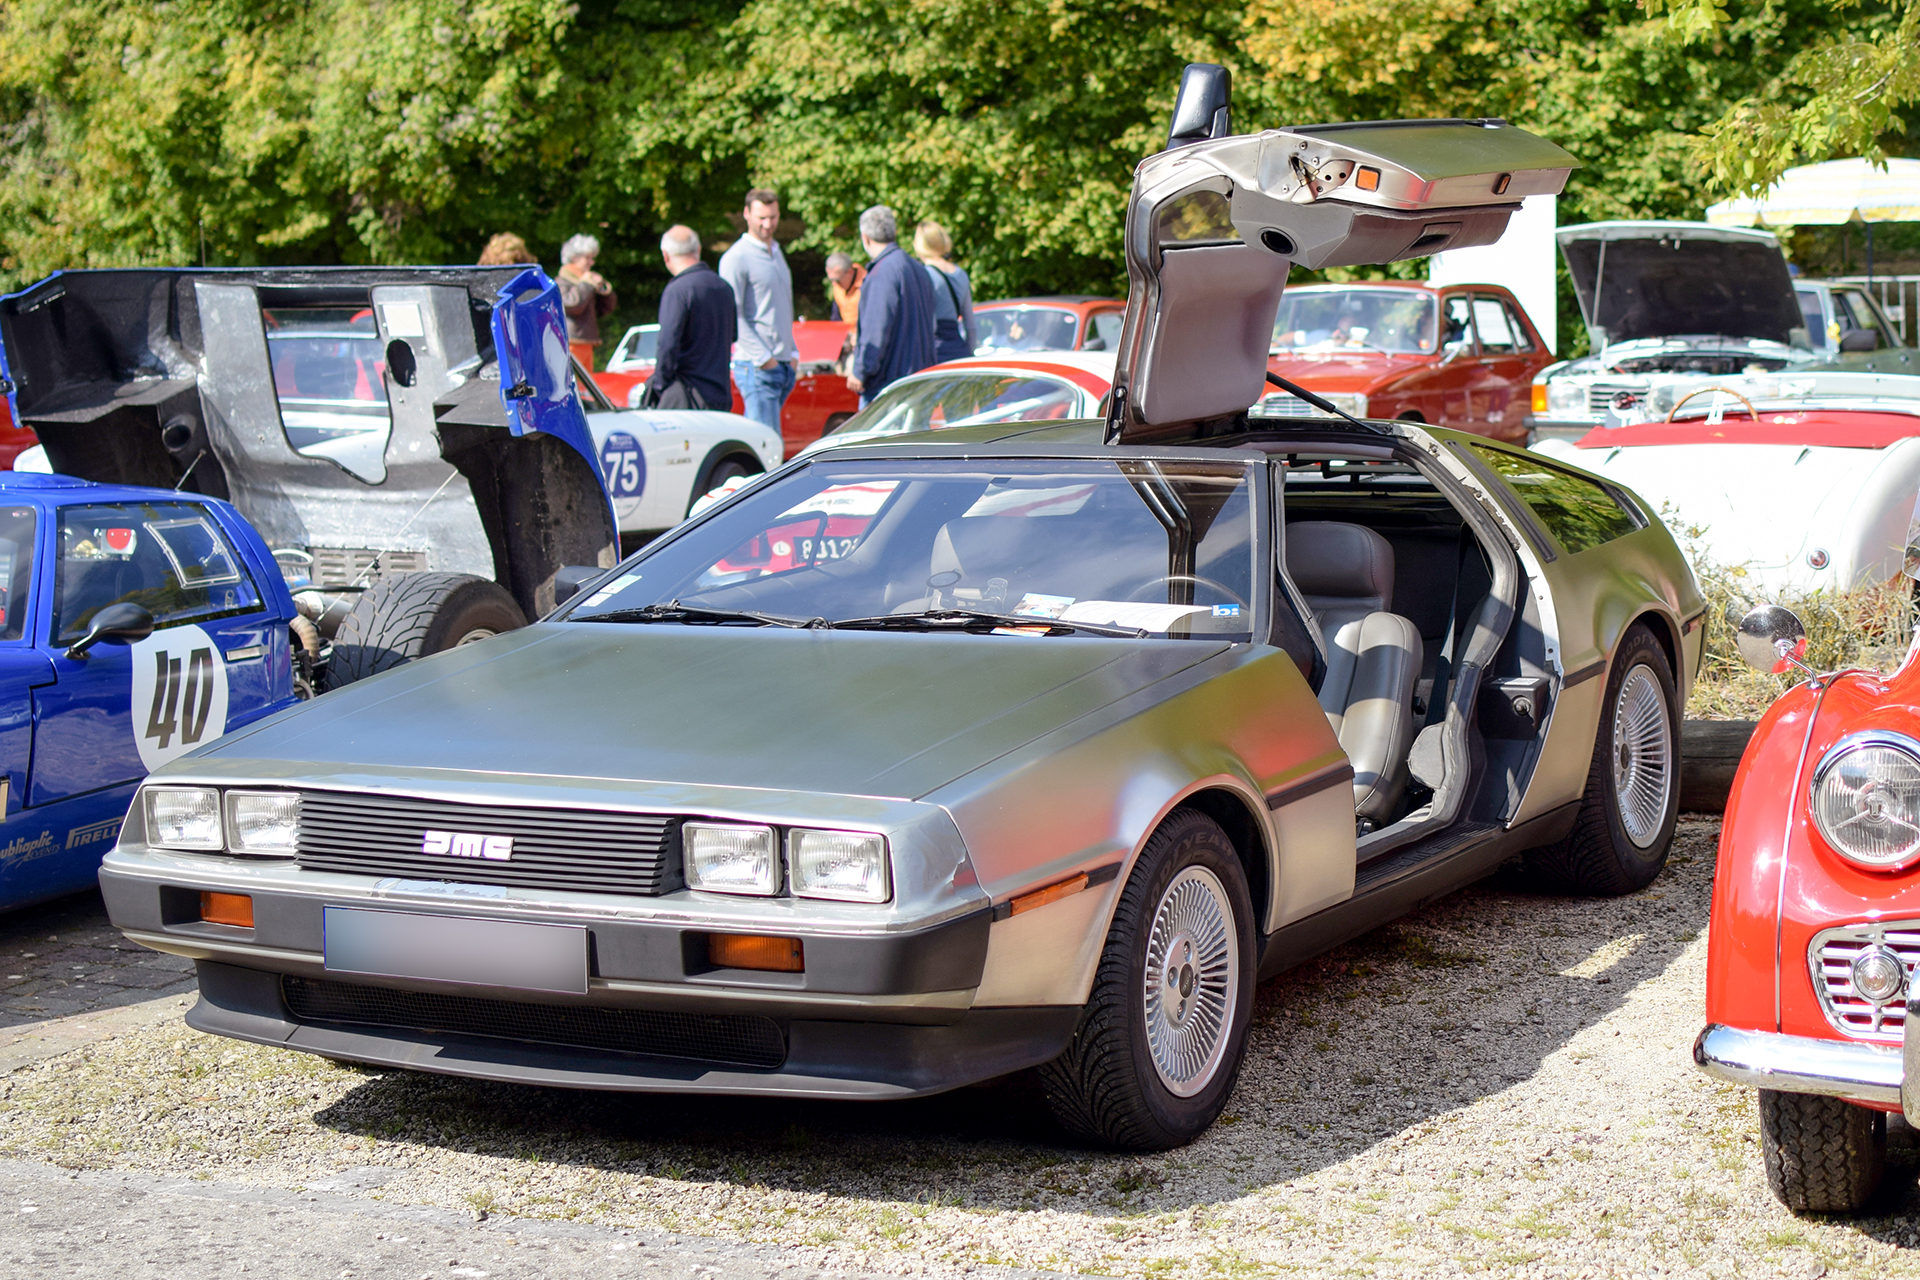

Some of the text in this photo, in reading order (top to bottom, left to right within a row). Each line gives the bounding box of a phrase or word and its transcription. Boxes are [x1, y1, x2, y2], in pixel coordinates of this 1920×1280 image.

[605, 451, 639, 493] 75
[802, 538, 858, 560] 8012
[144, 647, 215, 750] 40
[0, 830, 54, 860] ubliaplic
[65, 816, 125, 850] PIRELL
[422, 830, 514, 861] DMC
